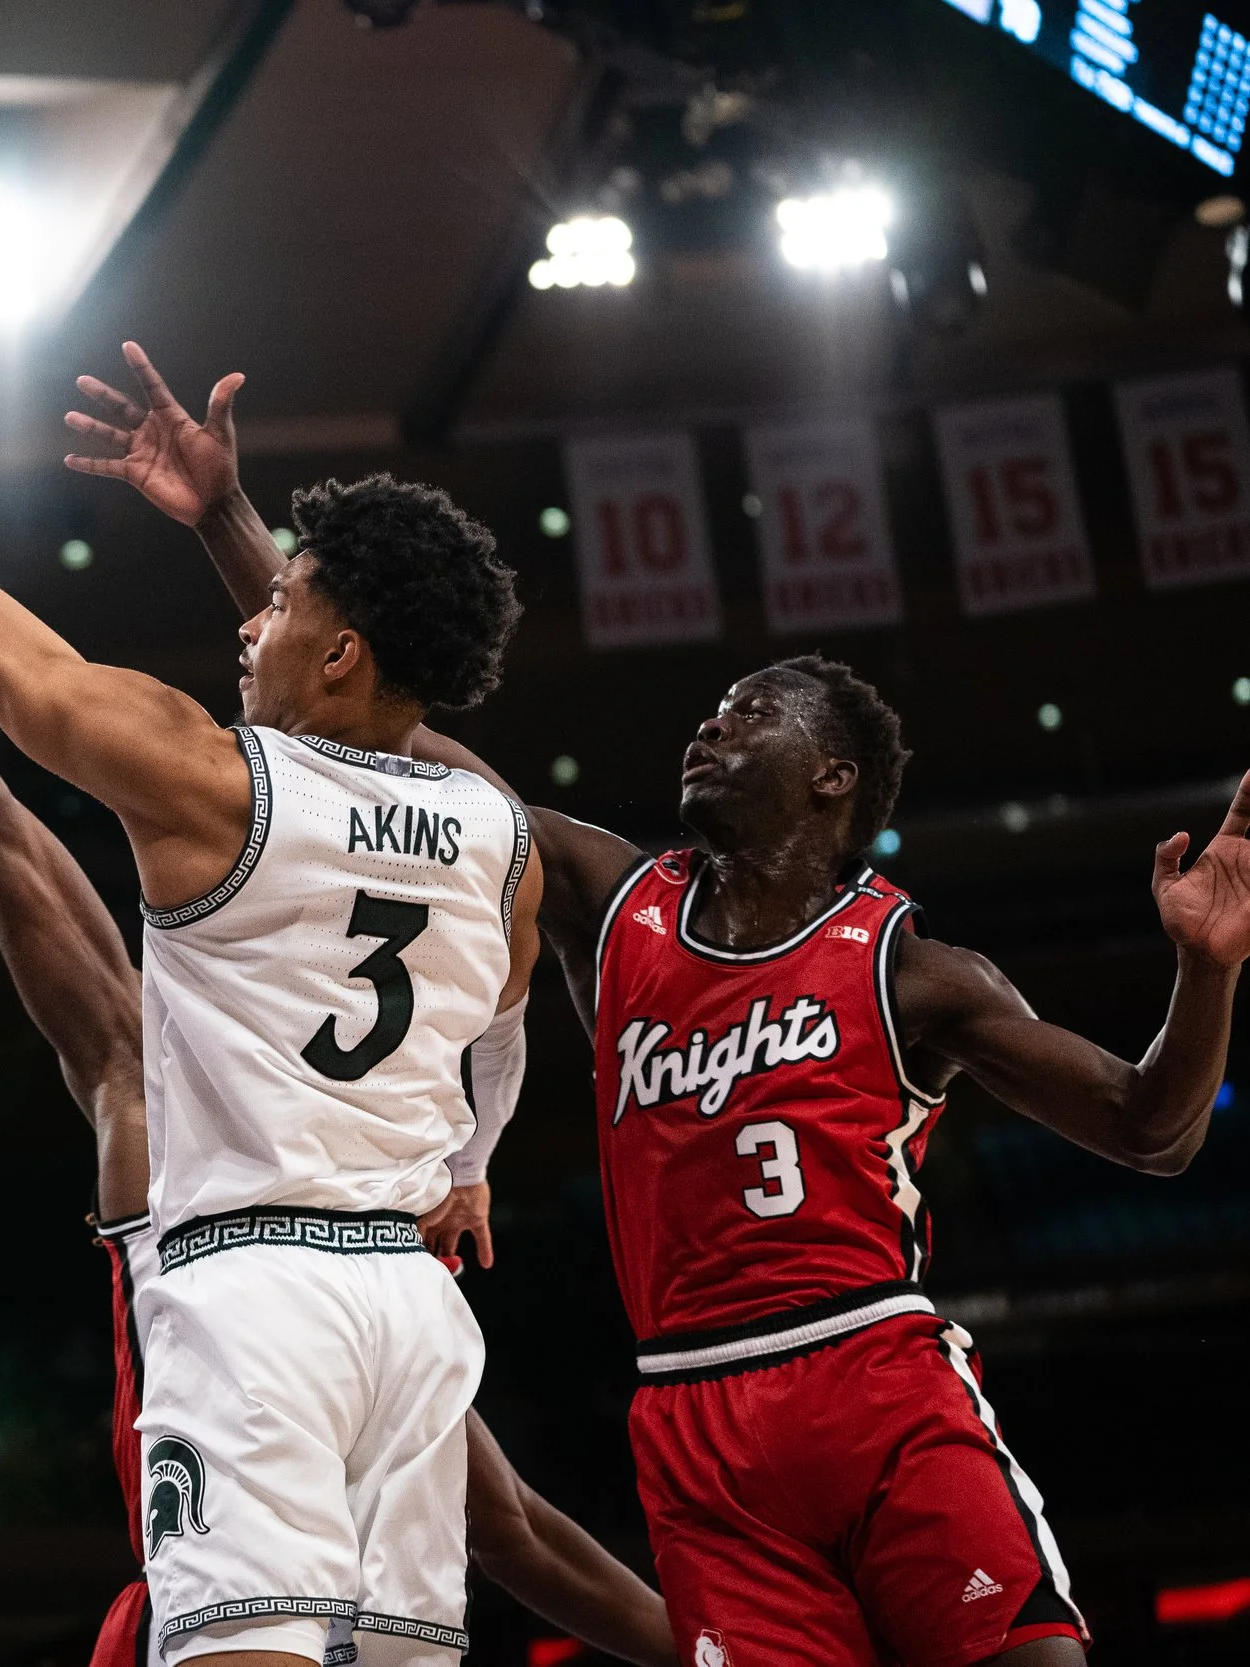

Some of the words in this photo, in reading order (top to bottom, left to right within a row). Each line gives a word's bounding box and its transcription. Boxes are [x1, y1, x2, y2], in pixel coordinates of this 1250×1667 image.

[967, 456, 1059, 545] 15
[1147, 430, 1240, 518] 15
[595, 490, 688, 578] 10
[776, 481, 867, 564] 12
[348, 805, 461, 866] AKINS
[300, 889, 430, 1082] 3
[613, 996, 839, 1127] Knights
[735, 1120, 807, 1219] 3
[962, 1584, 1004, 1603] adidas
